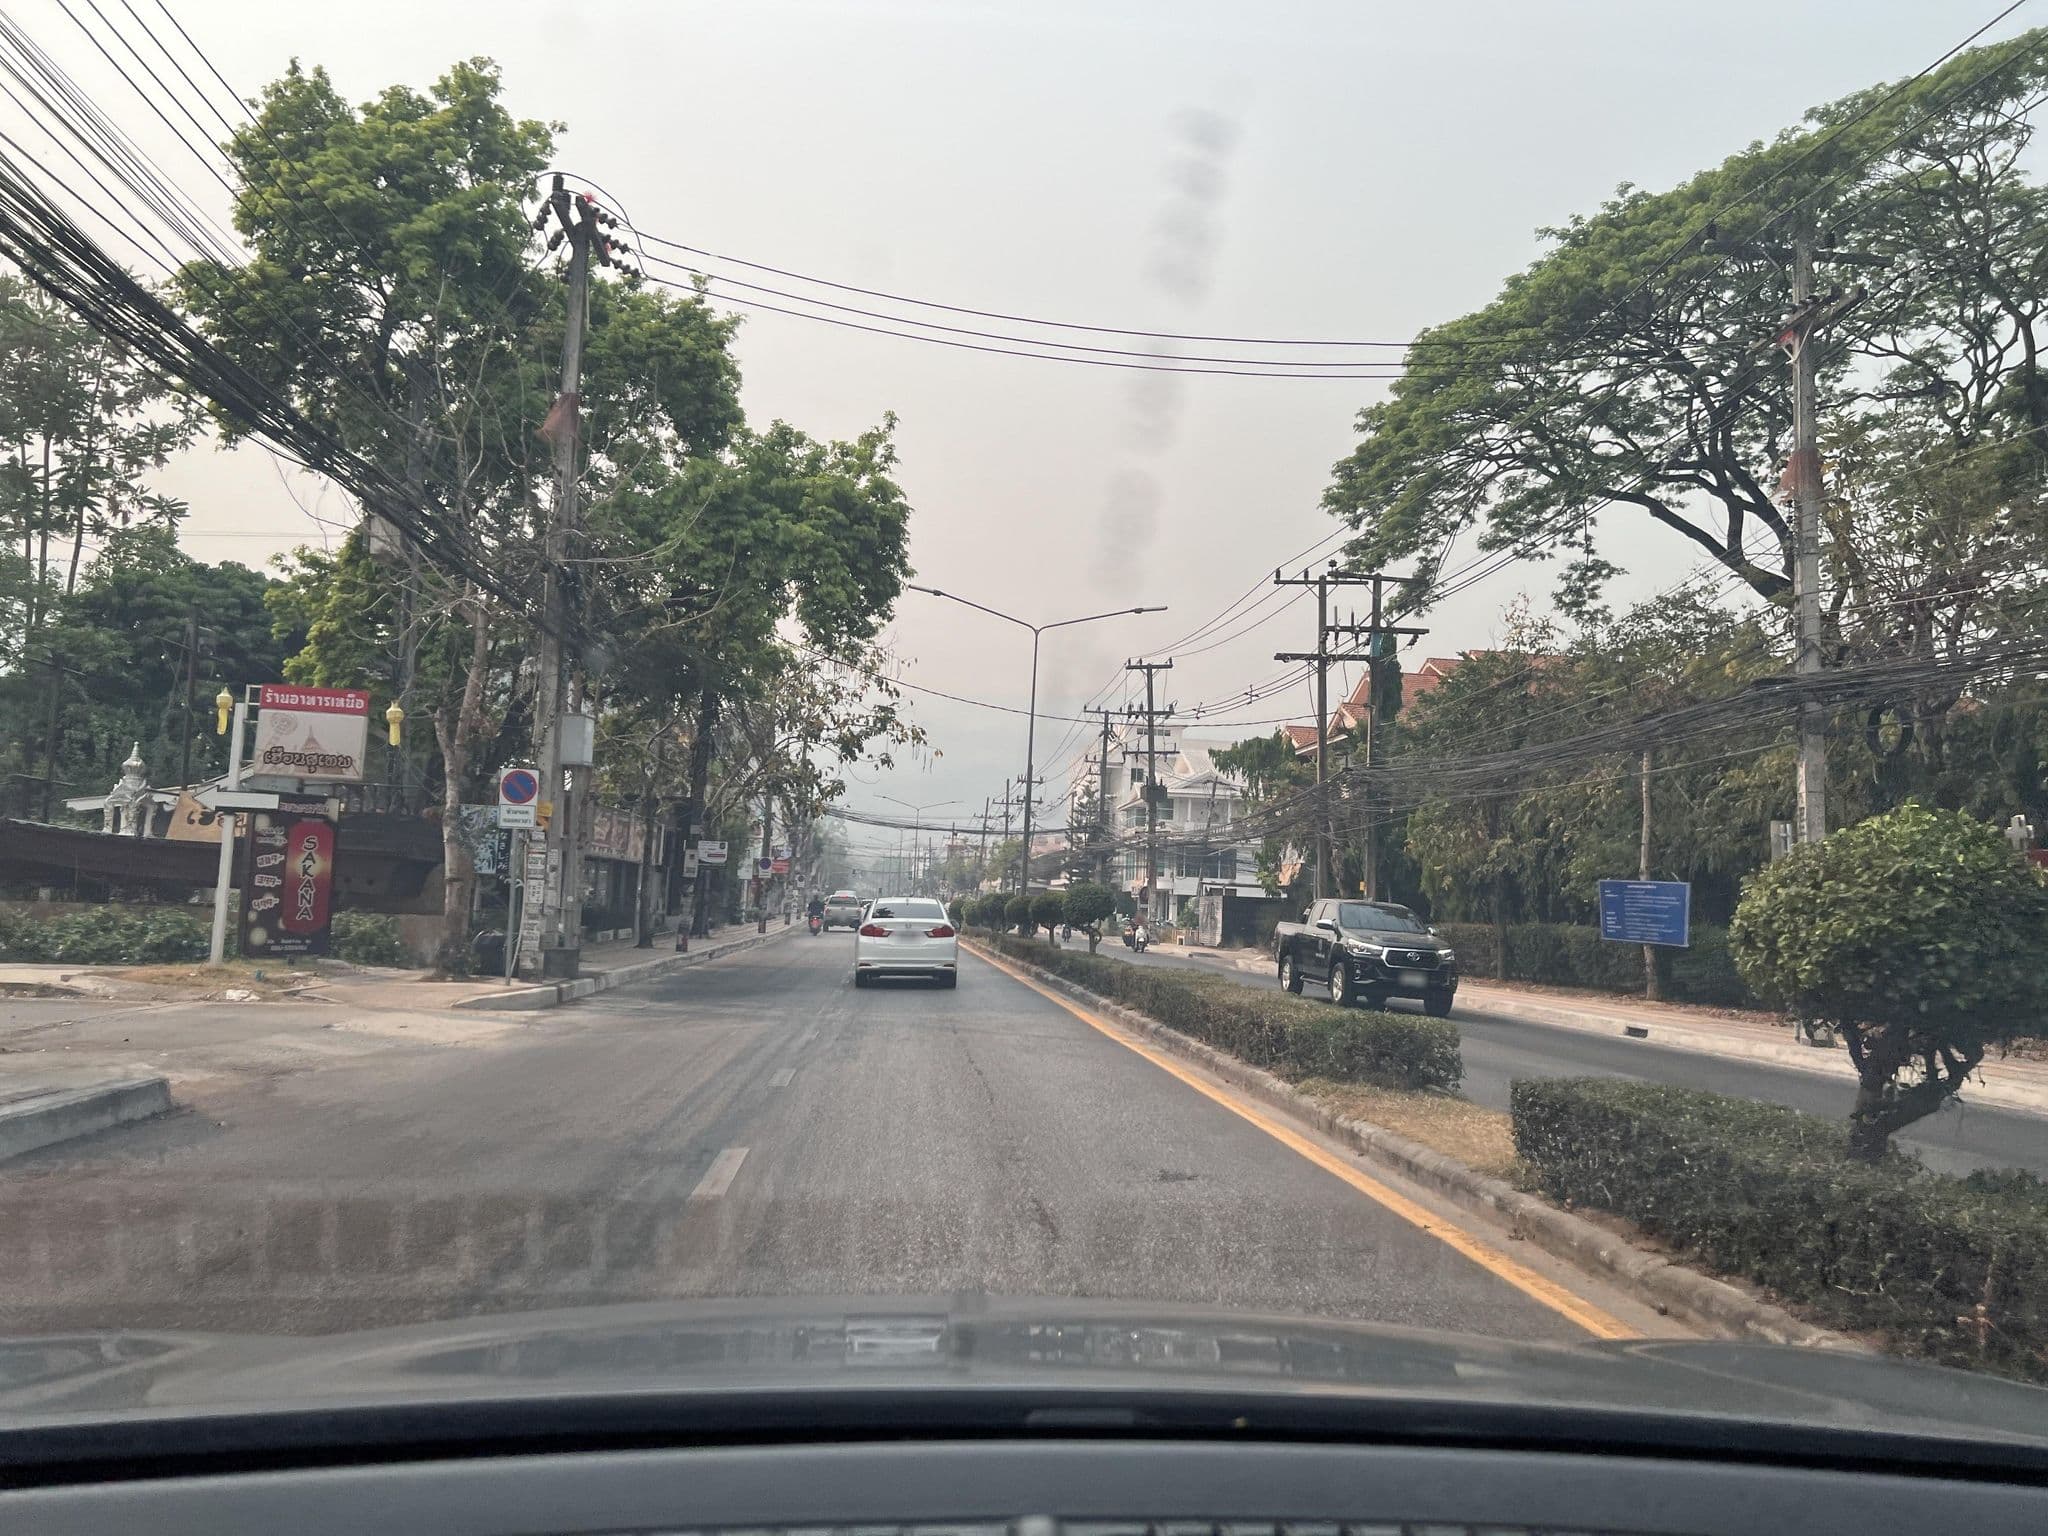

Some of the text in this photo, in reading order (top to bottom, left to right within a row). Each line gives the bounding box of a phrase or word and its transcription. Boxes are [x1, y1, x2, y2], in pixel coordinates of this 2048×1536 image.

[265, 688, 365, 709] ร้านอาหารเหนือ
[296, 836, 318, 920] SAKANA
